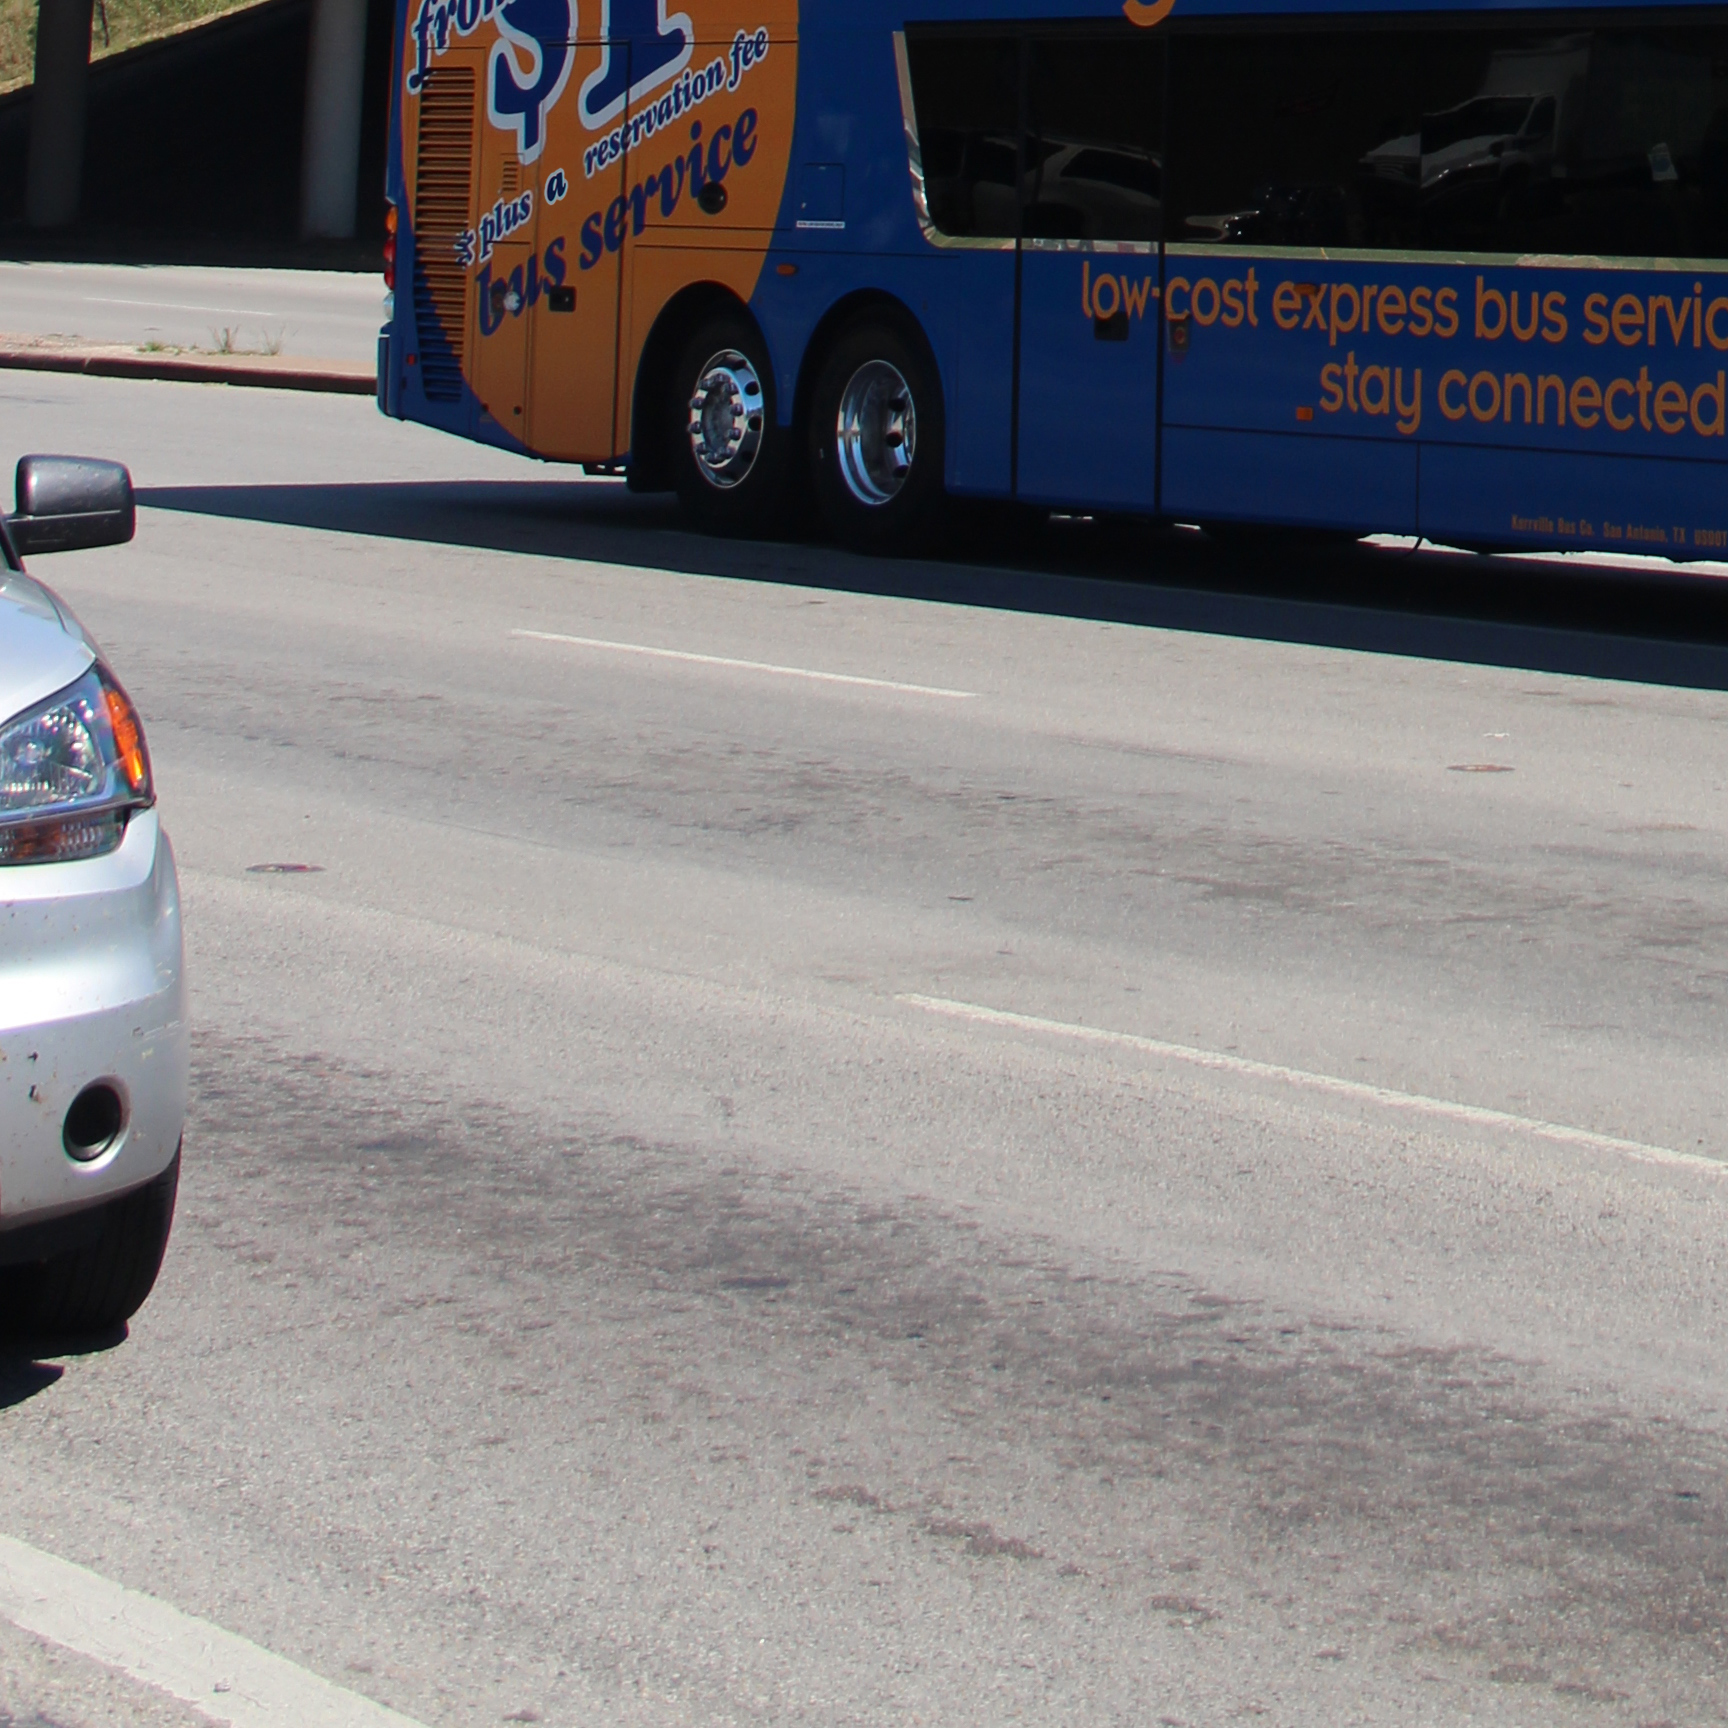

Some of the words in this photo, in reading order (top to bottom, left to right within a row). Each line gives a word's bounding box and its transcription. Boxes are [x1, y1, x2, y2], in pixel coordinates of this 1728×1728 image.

[546, 170, 567, 203] a
[583, 56, 725, 176] reservation
[728, 29, 768, 89] fee
[476, 236, 567, 336] bus
[579, 107, 758, 271] service
[1082, 261, 1259, 328] low-cost
[1272, 280, 1459, 347] express
[1475, 275, 1568, 343] bus
[1319, 351, 1422, 434] stay
[1603, 521, 1622, 539] San
[1673, 526, 1685, 543] TX
